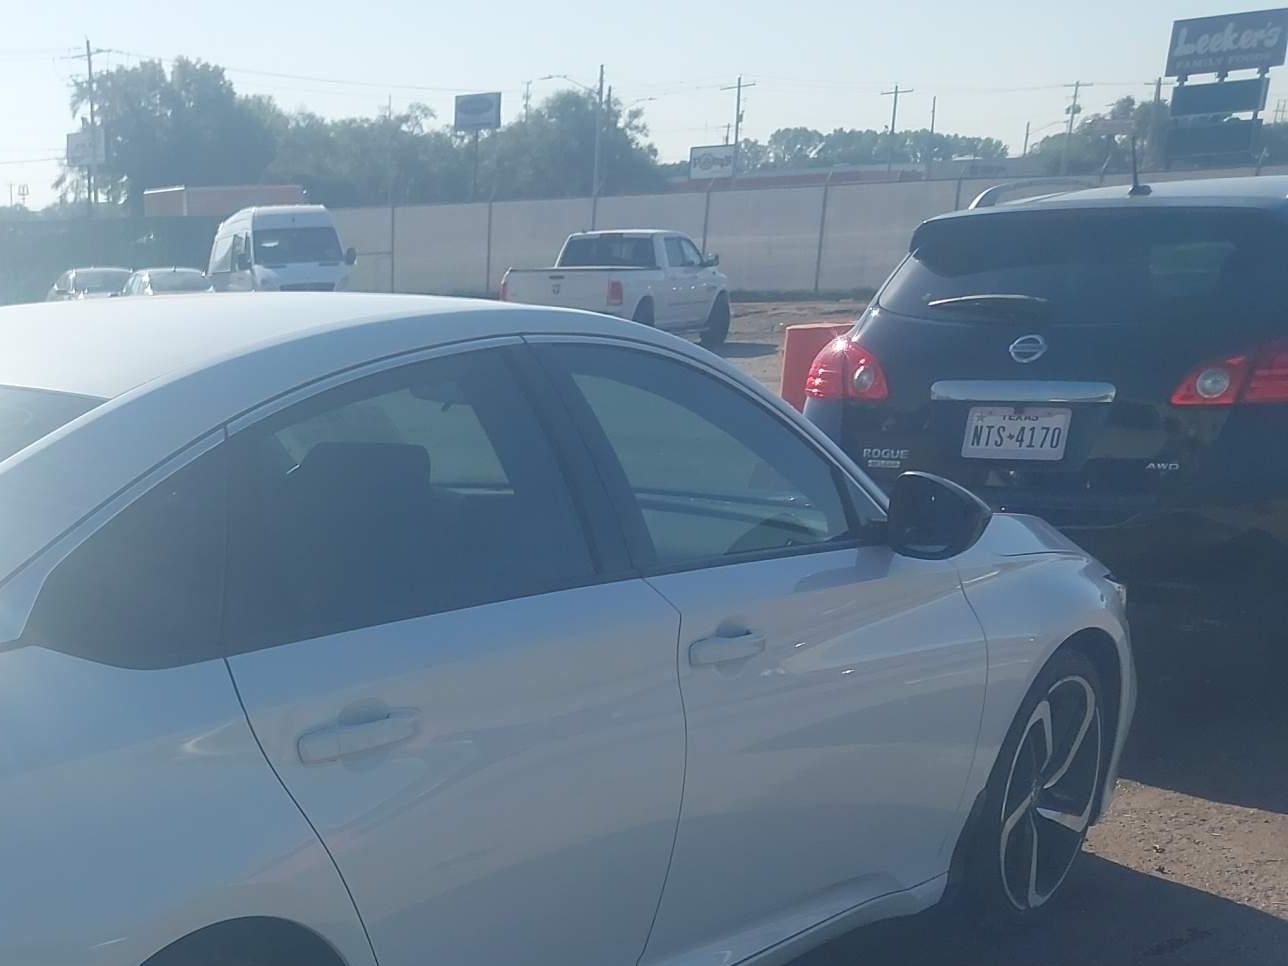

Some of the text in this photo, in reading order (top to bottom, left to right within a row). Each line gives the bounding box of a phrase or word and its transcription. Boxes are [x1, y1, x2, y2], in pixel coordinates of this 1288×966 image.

[1173, 22, 1283, 57] Leeker's
[863, 448, 910, 459] ROGUE
[1145, 462, 1180, 471] AWD
